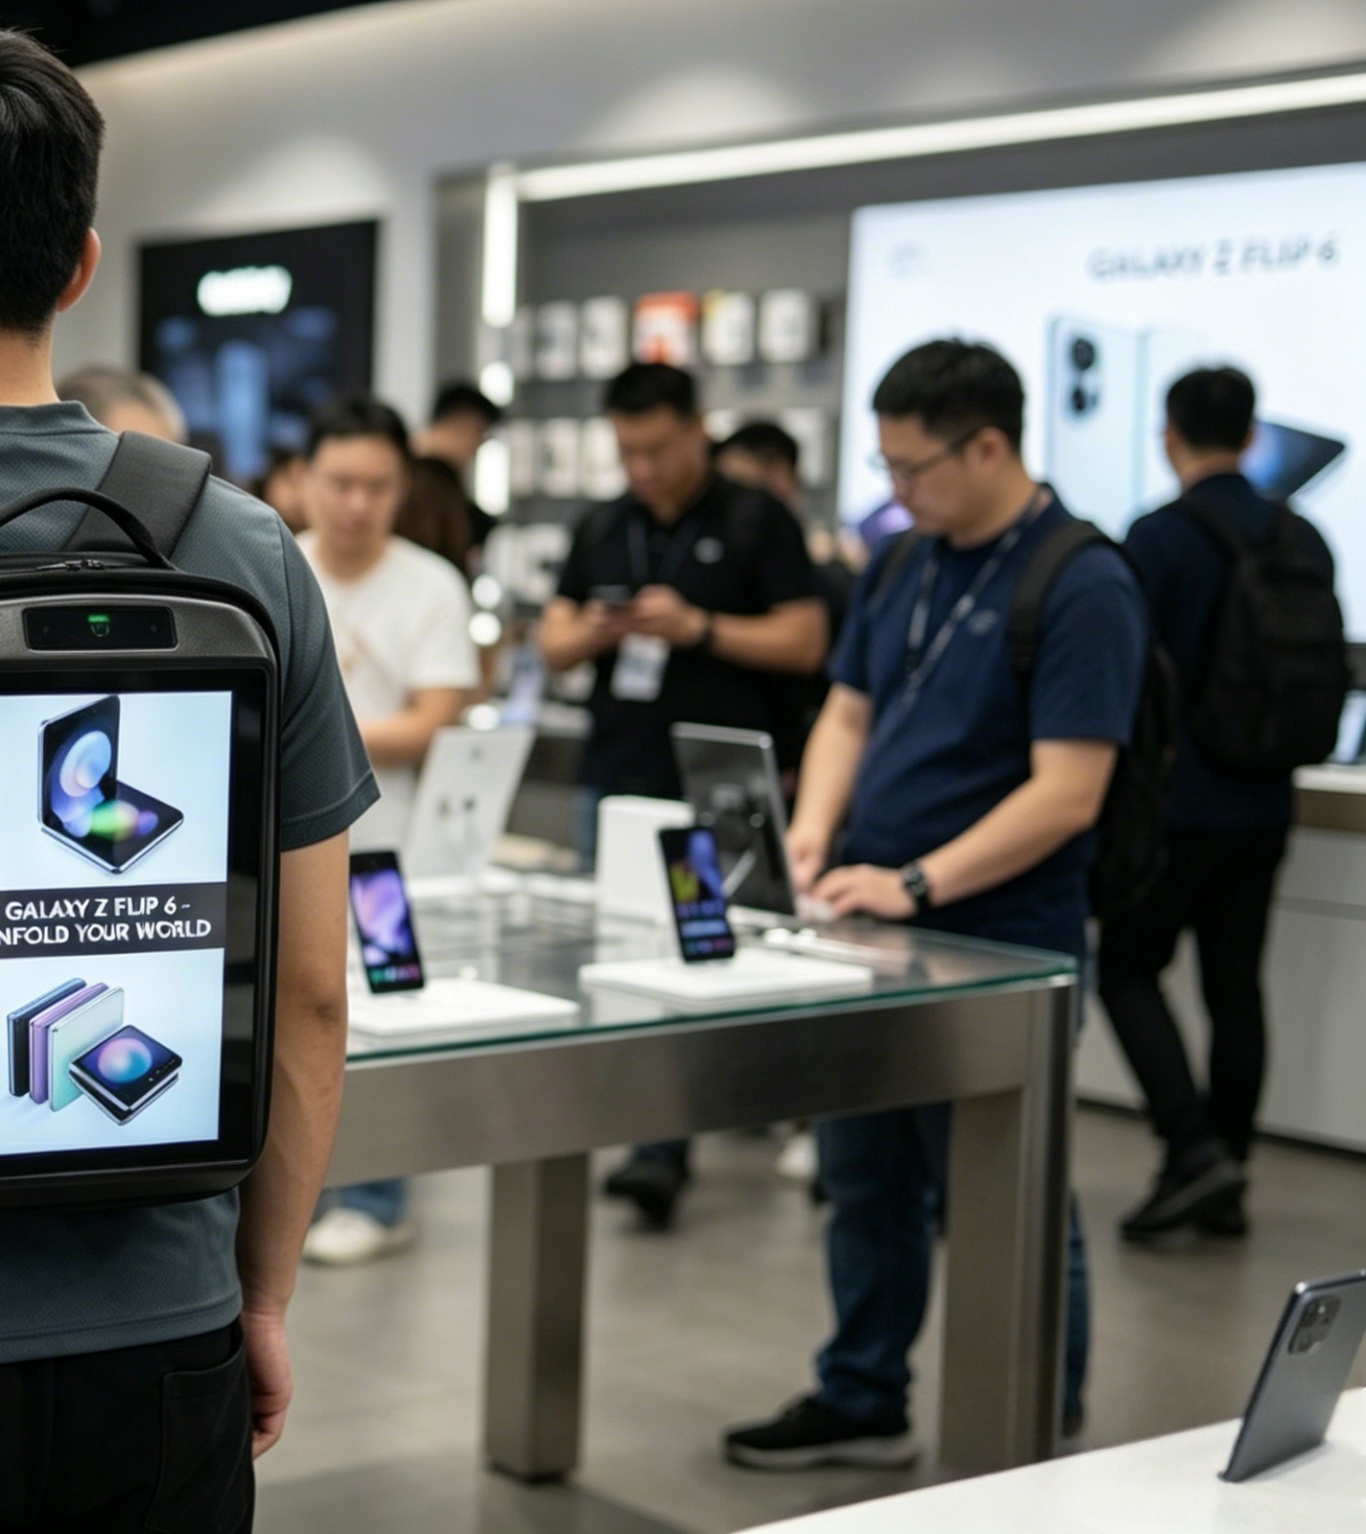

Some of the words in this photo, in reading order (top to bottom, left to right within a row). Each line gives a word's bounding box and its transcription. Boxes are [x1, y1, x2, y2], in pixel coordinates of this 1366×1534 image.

[5, 899, 90, 921] GALAXY
[93, 898, 109, 917] Z
[114, 897, 159, 917] FLIP
[163, 896, 177, 915] 6
[74, 922, 130, 943] YOUR
[136, 919, 212, 940] WORLD
